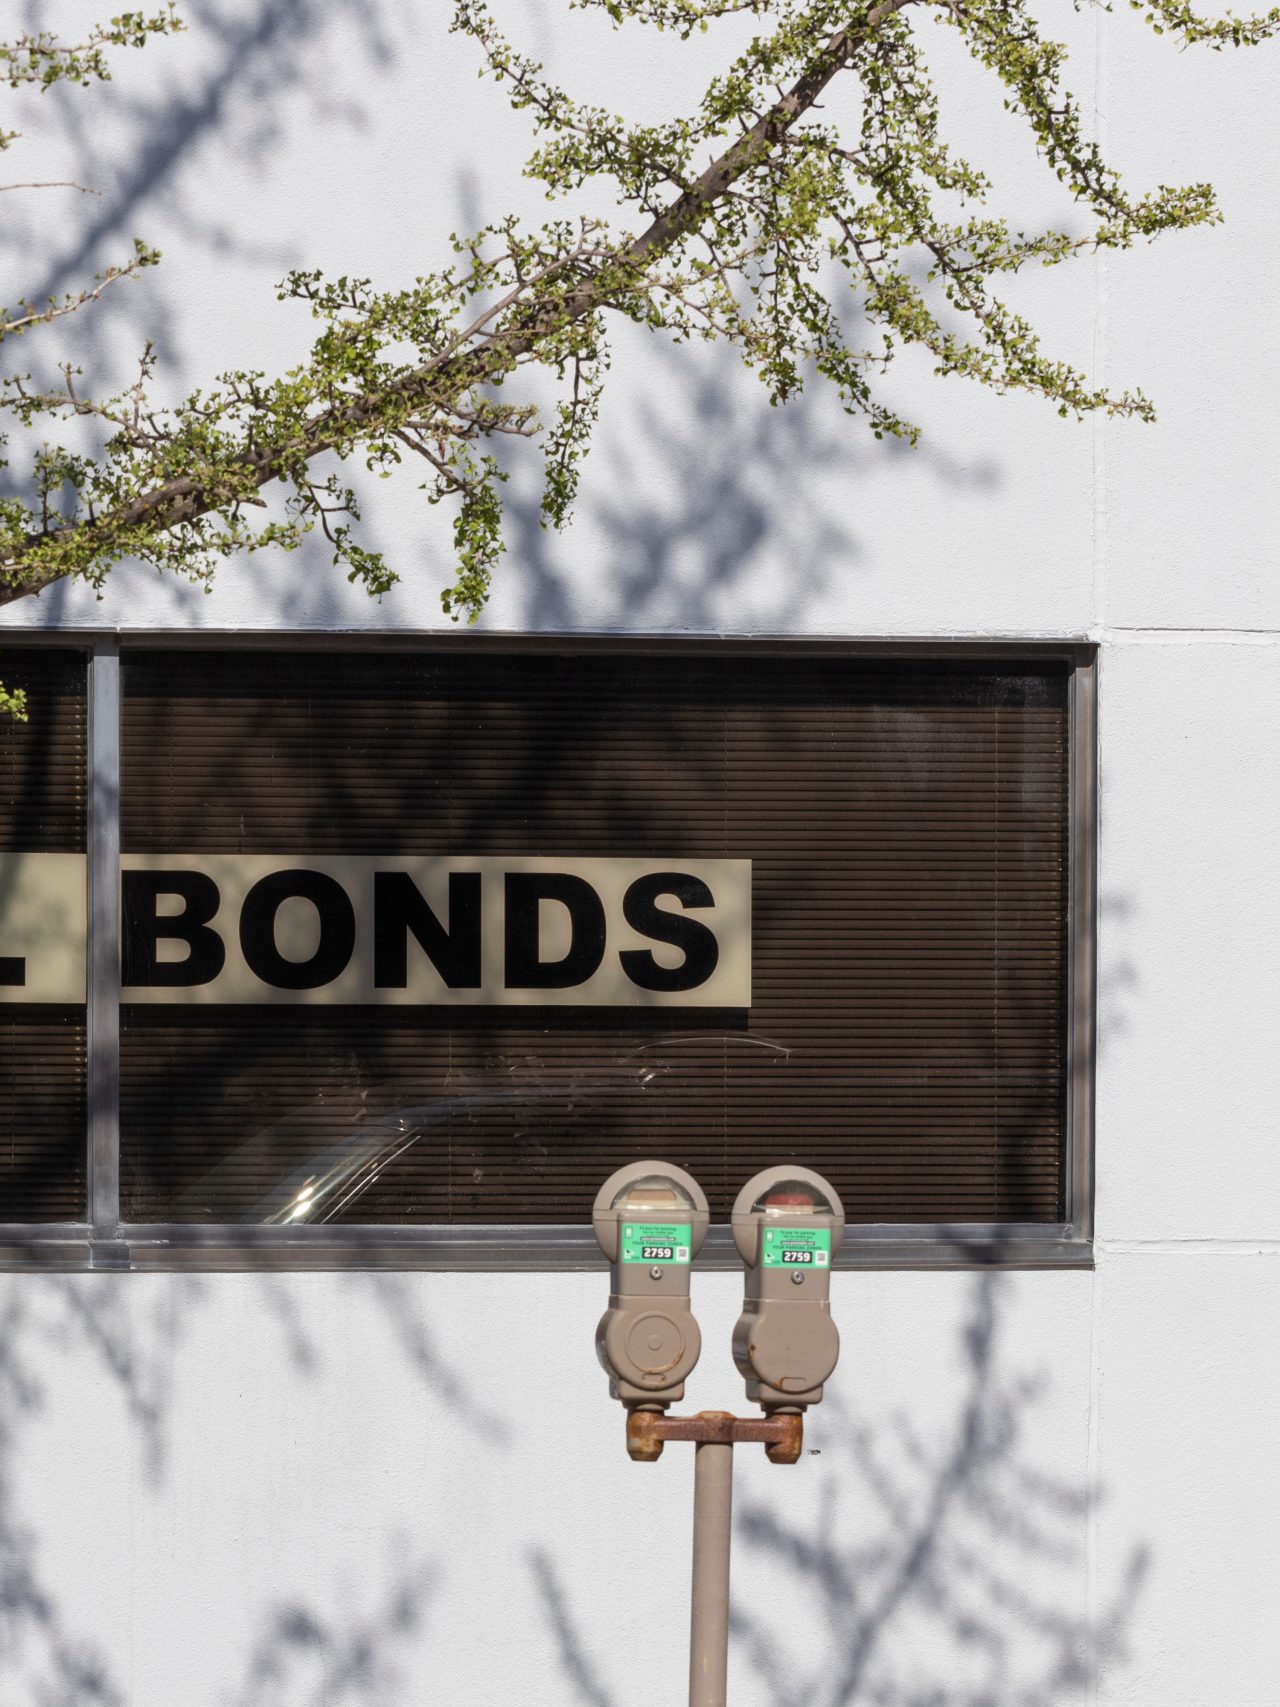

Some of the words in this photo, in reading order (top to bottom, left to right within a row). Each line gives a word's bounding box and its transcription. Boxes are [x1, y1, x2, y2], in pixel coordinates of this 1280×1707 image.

[120, 869, 719, 992] BONDS
[644, 1247, 672, 1258] 2759
[784, 1251, 811, 1262] 2759
